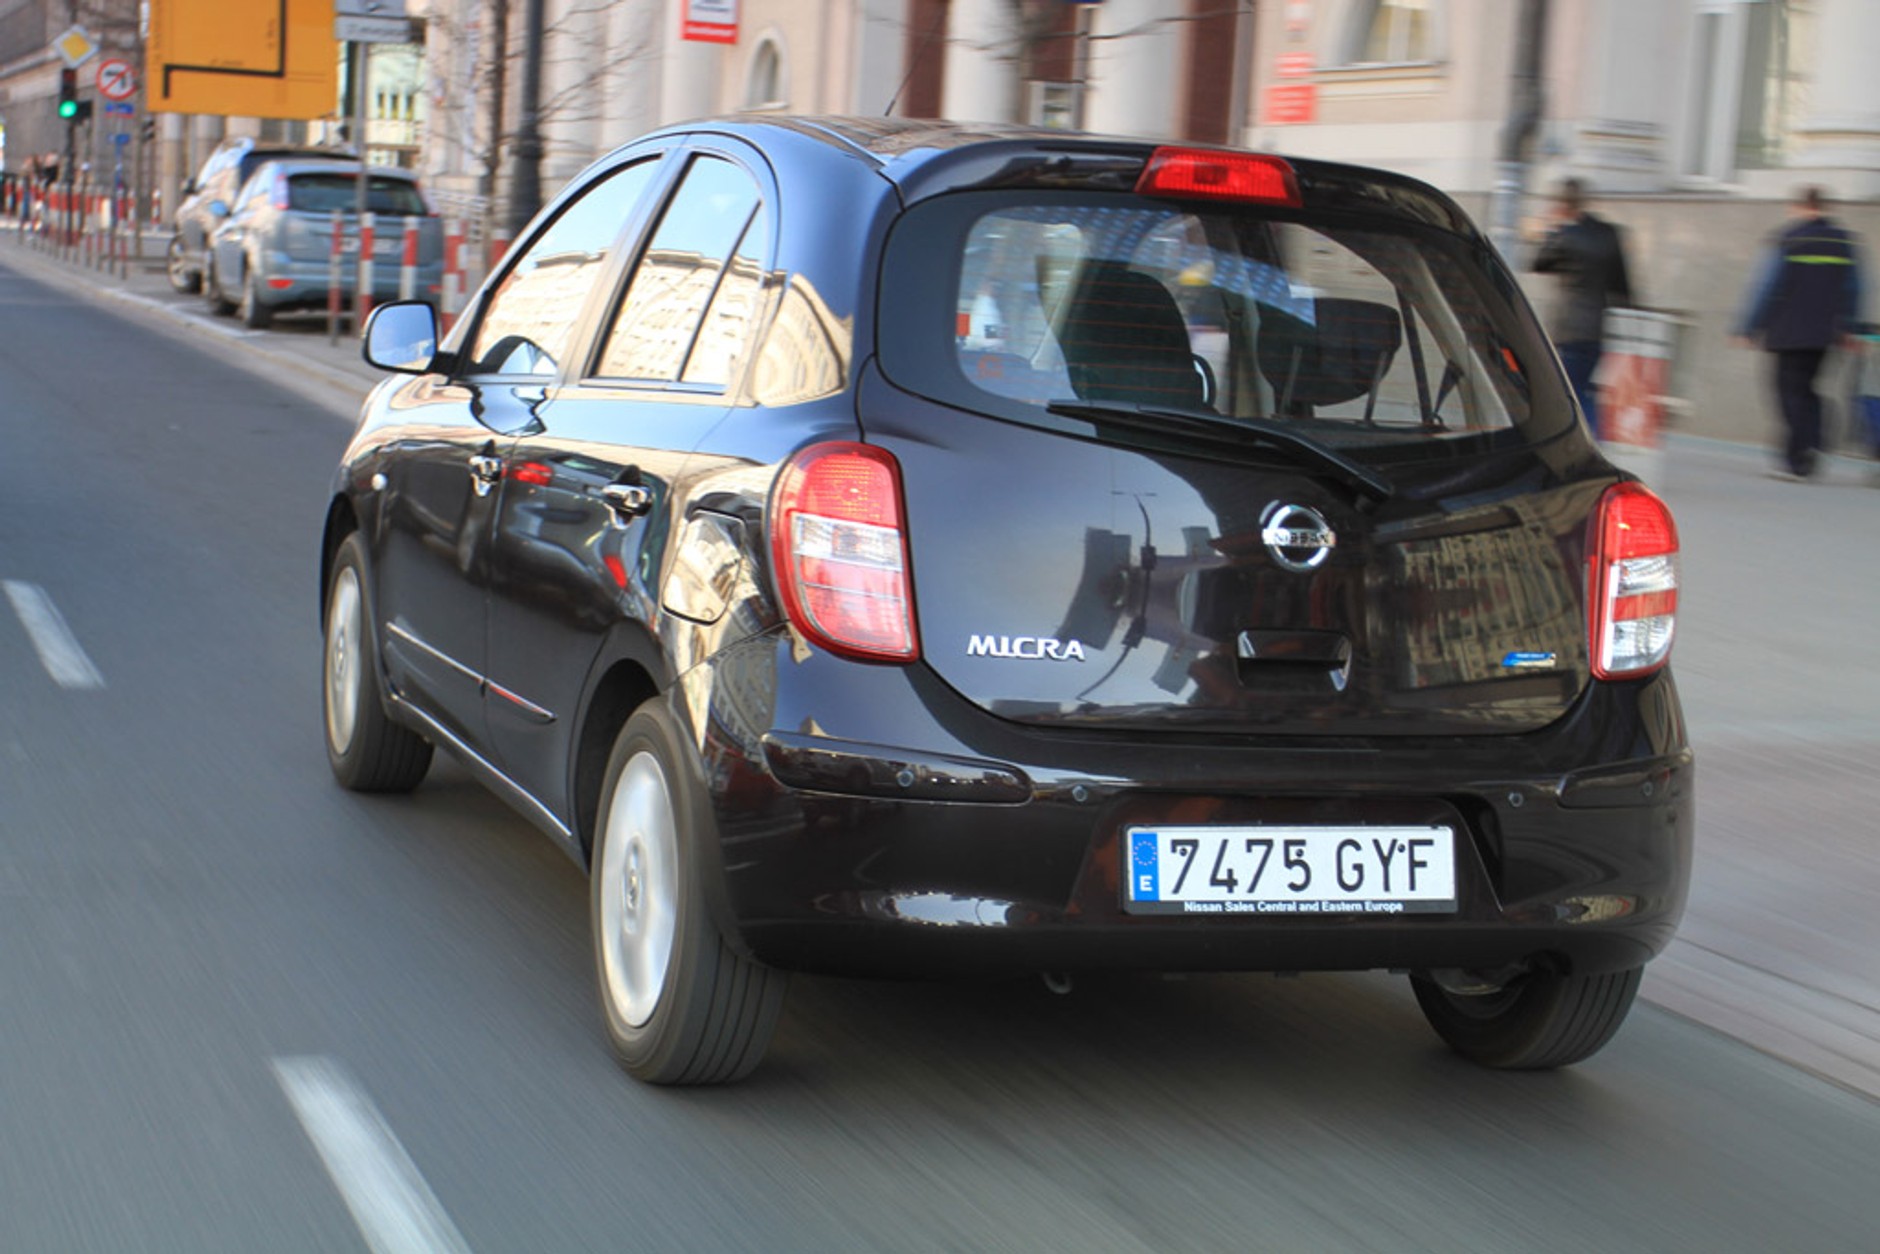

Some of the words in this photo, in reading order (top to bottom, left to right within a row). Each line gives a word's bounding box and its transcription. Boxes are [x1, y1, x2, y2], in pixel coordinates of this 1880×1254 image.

[966, 635, 1085, 661] MICRA
[1170, 838, 1312, 894] 7475
[1336, 838, 1434, 893] GYF
[1139, 875, 1153, 891] E
[1184, 901, 1222, 912] Nissan
[1225, 901, 1255, 912] Sales
[1257, 901, 1296, 912] Central
[1299, 902, 1319, 912] and
[1321, 901, 1363, 912] Eastern
[1365, 902, 1404, 914] Europe
